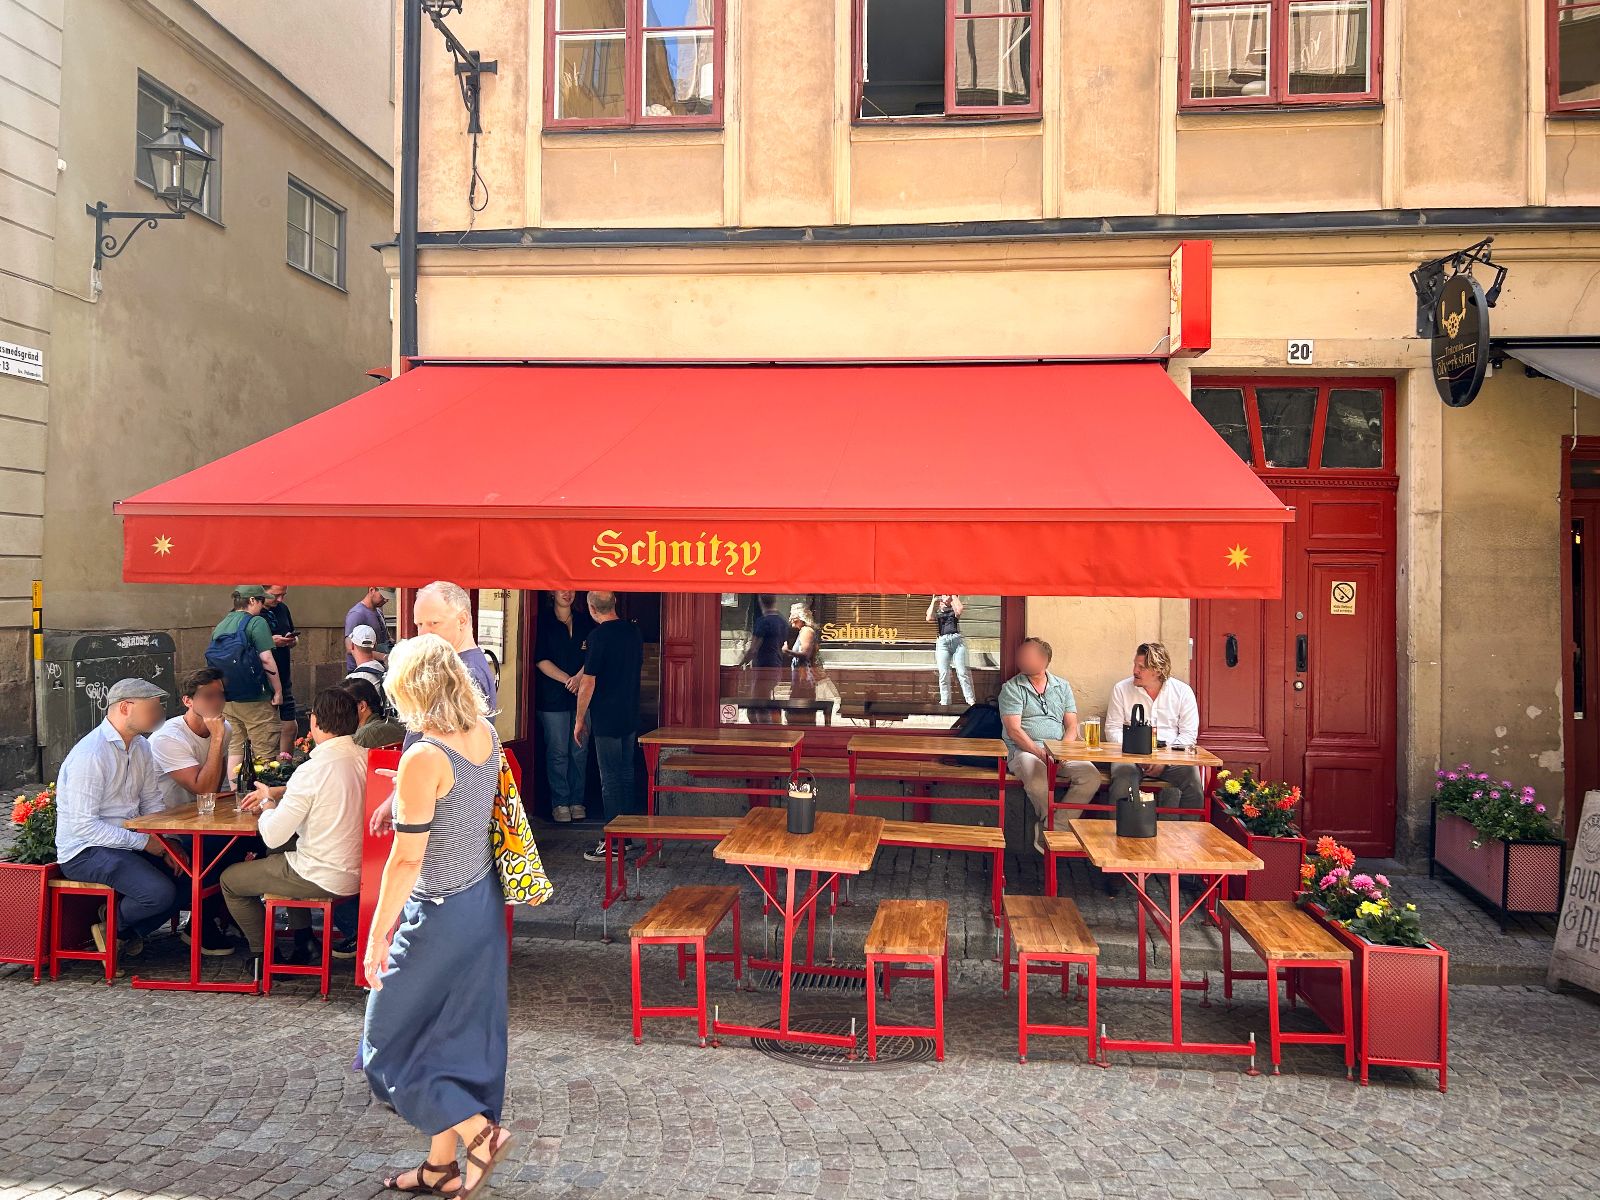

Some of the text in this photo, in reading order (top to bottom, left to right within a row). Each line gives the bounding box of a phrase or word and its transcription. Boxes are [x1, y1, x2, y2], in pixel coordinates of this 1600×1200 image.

[1290, 343, 1310, 360] 20
[591, 529, 762, 576] Schnitzy
[820, 622, 898, 645] Schnitzy
[1569, 865, 1600, 903] BUR
[1575, 904, 1600, 954] BE
